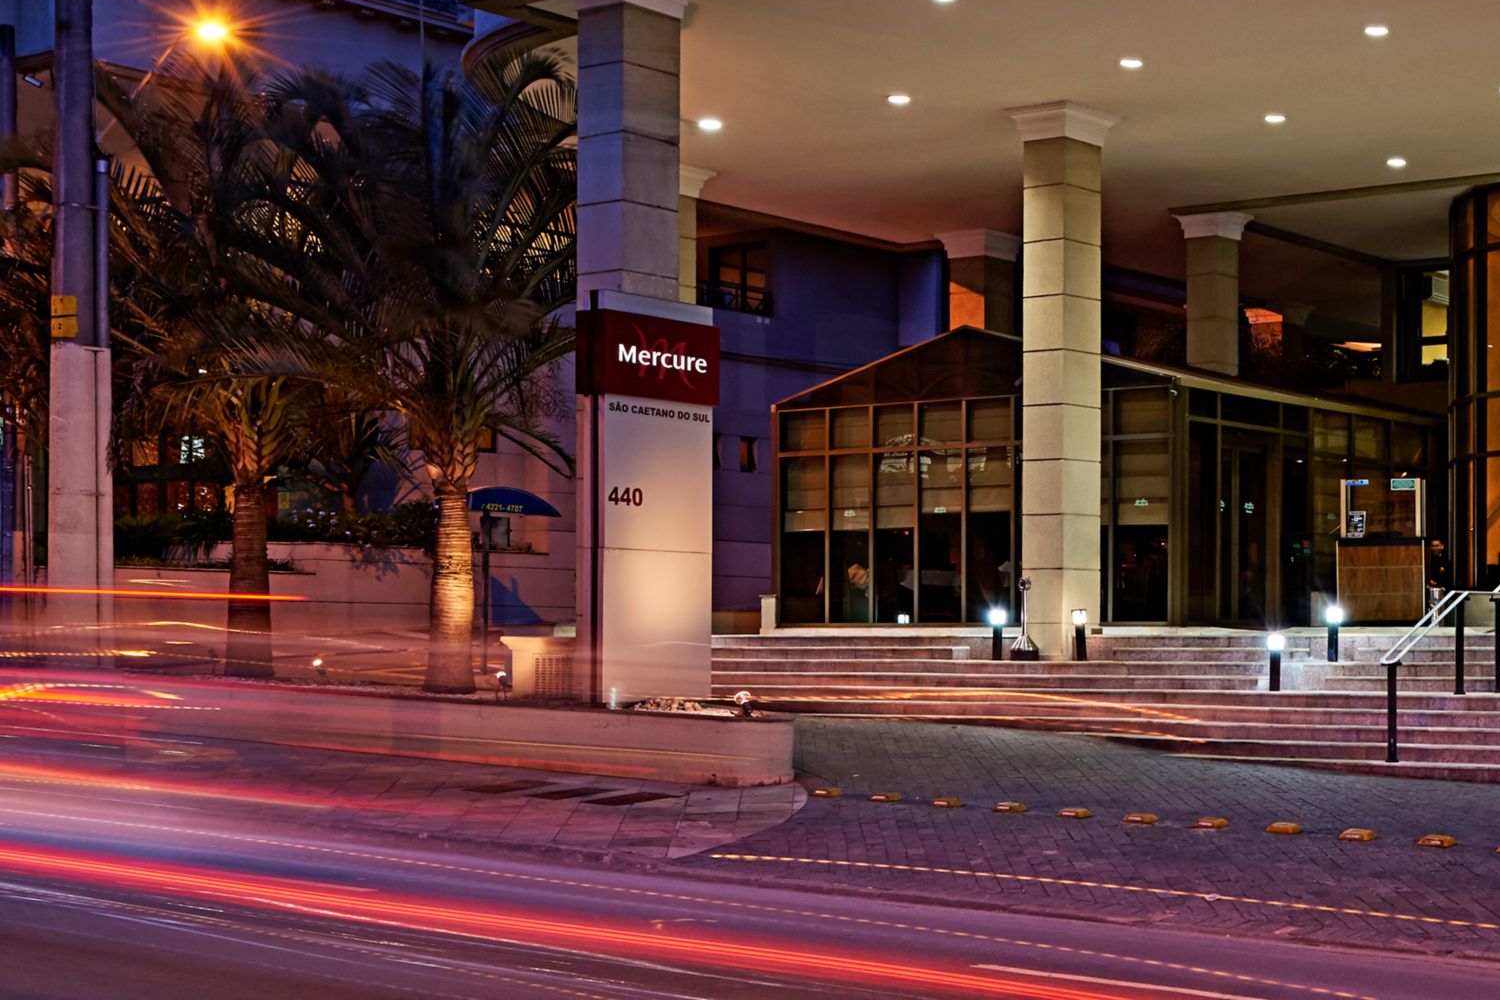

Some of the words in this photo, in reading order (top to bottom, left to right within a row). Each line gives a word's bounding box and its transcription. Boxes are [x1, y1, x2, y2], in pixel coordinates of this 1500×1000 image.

[618, 343, 708, 374] Mercure
[608, 401, 629, 413] SÃO
[631, 405, 675, 419] CAETANO
[677, 410, 691, 421] DO
[692, 412, 711, 423] SUL
[608, 486, 643, 507] 440
